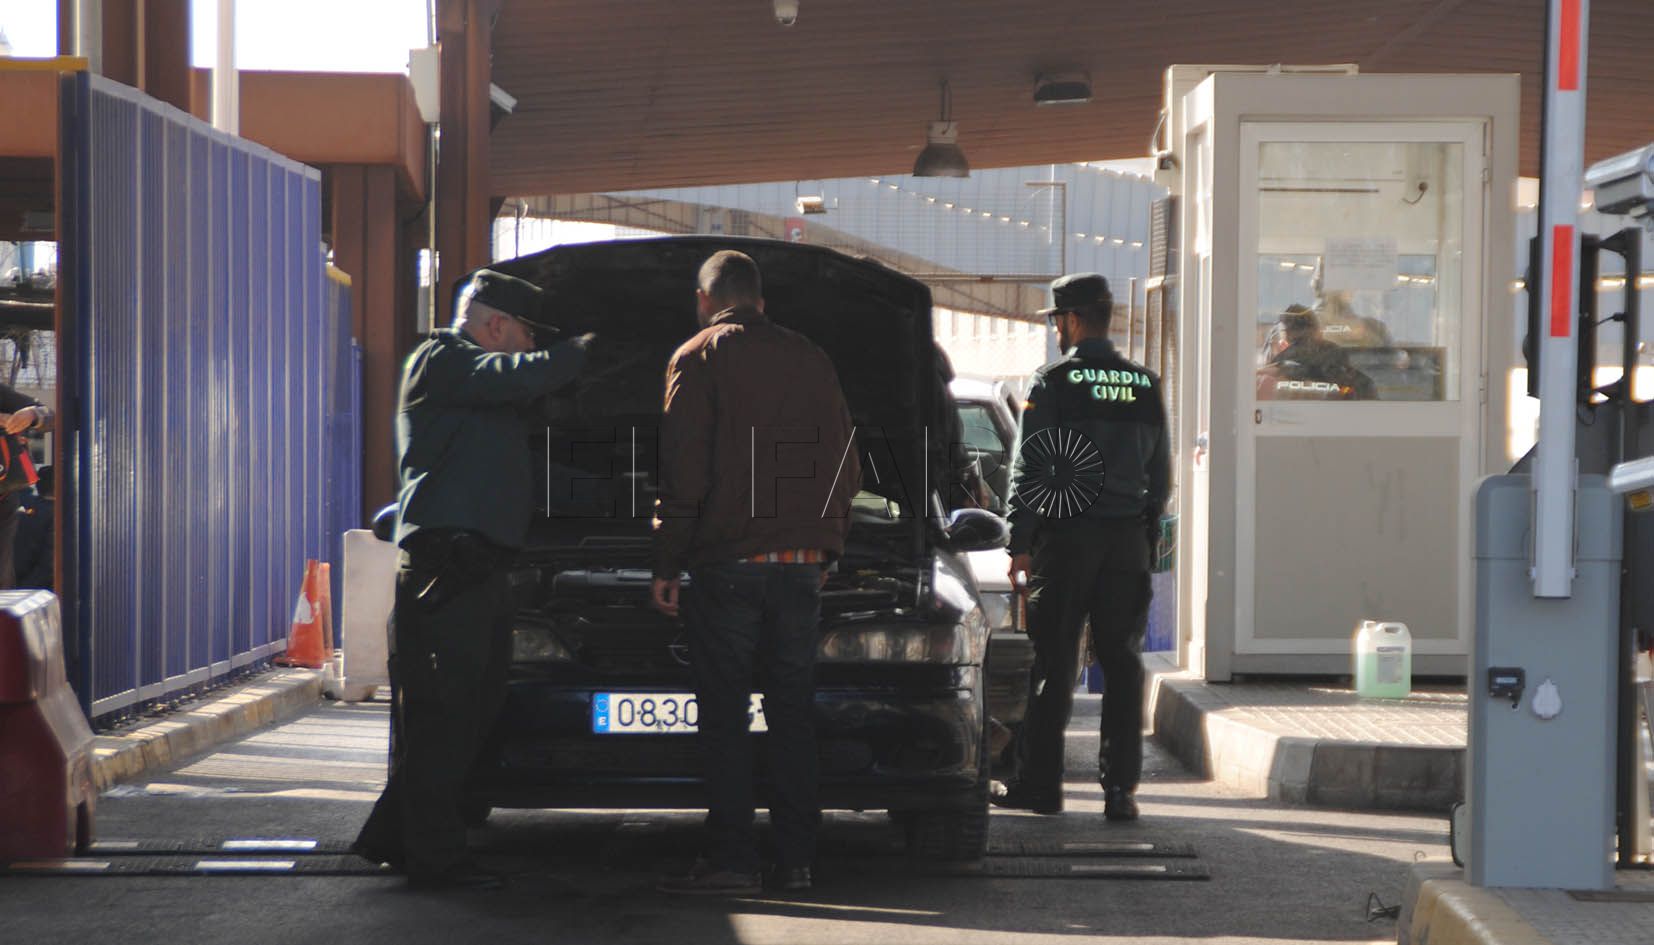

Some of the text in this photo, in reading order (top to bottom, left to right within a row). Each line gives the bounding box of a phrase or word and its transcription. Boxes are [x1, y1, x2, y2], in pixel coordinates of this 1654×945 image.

[1068, 365, 1152, 387] GUARDIA
[1092, 384, 1137, 401] CIVIL
[1277, 380, 1340, 392] POLICIA
[618, 698, 699, 727] 0830
